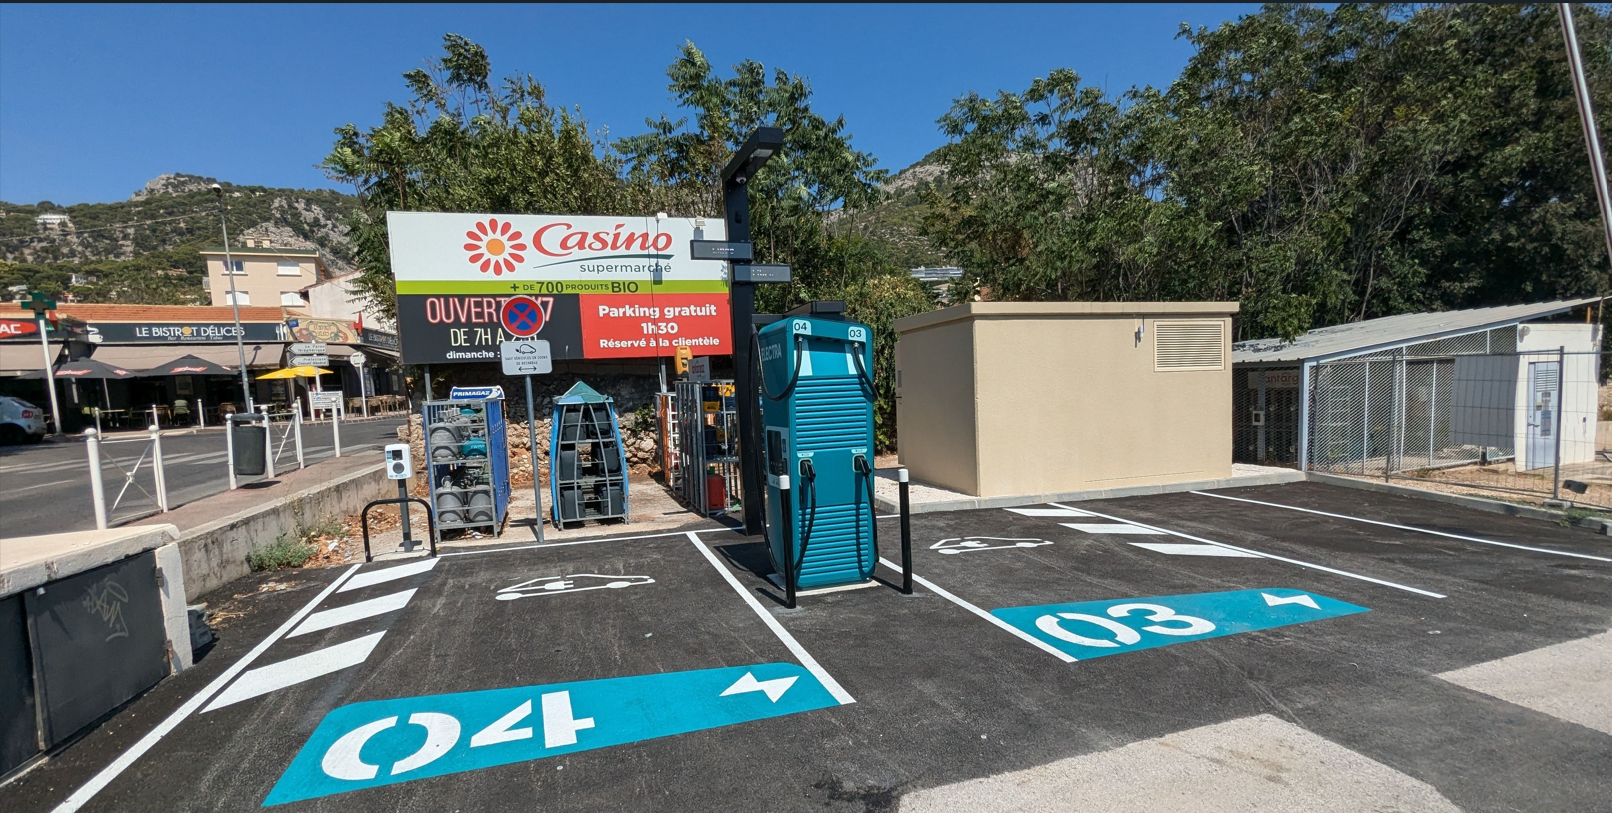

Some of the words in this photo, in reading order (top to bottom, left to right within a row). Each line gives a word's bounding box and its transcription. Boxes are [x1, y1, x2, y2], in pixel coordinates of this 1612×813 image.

[533, 223, 672, 257] Casino
[580, 263, 672, 275] supermarché
[537, 281, 564, 293] 700
[565, 283, 609, 291] PRODUITS
[611, 281, 638, 293] BIO
[598, 305, 660, 319] Parking
[664, 304, 717, 319] gratuit
[136, 327, 149, 337] LE
[152, 326, 198, 337] BISTROT
[201, 325, 245, 336] DÉLICES
[641, 322, 678, 335] 1h30
[793, 322, 807, 331] 04
[450, 328, 470, 346] DE
[473, 328, 491, 346] 7H
[496, 327, 505, 345] A
[849, 329, 862, 338] 03
[600, 338, 646, 349] Réservé
[649, 337, 656, 348] à
[659, 337, 672, 347] la
[673, 336, 720, 347] clientèle
[446, 350, 495, 359] dimanche
[761, 343, 782, 362] ELECTRA
[1034, 603, 1216, 647] 03
[321, 690, 595, 781] 04
